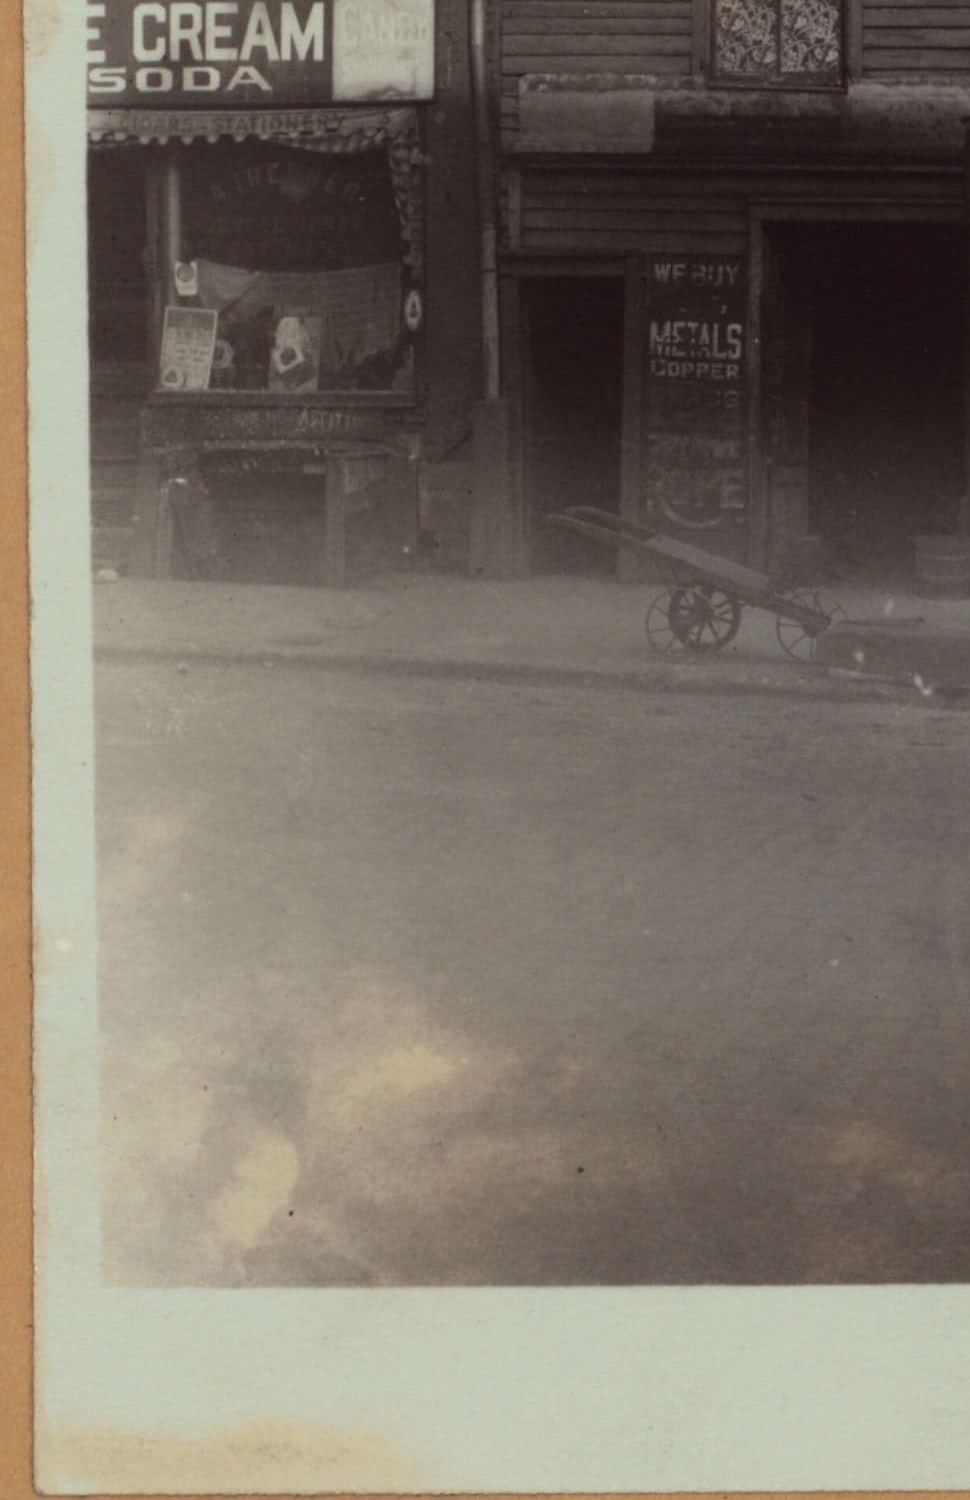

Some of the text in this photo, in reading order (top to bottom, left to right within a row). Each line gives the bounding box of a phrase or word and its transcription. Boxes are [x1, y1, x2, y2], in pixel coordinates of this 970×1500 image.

[132, 2, 325, 63] CREAM
[88, 65, 273, 93] SODA
[691, 263, 739, 286] BUY
[649, 320, 743, 361] METALS
[650, 359, 740, 381] COPPER
